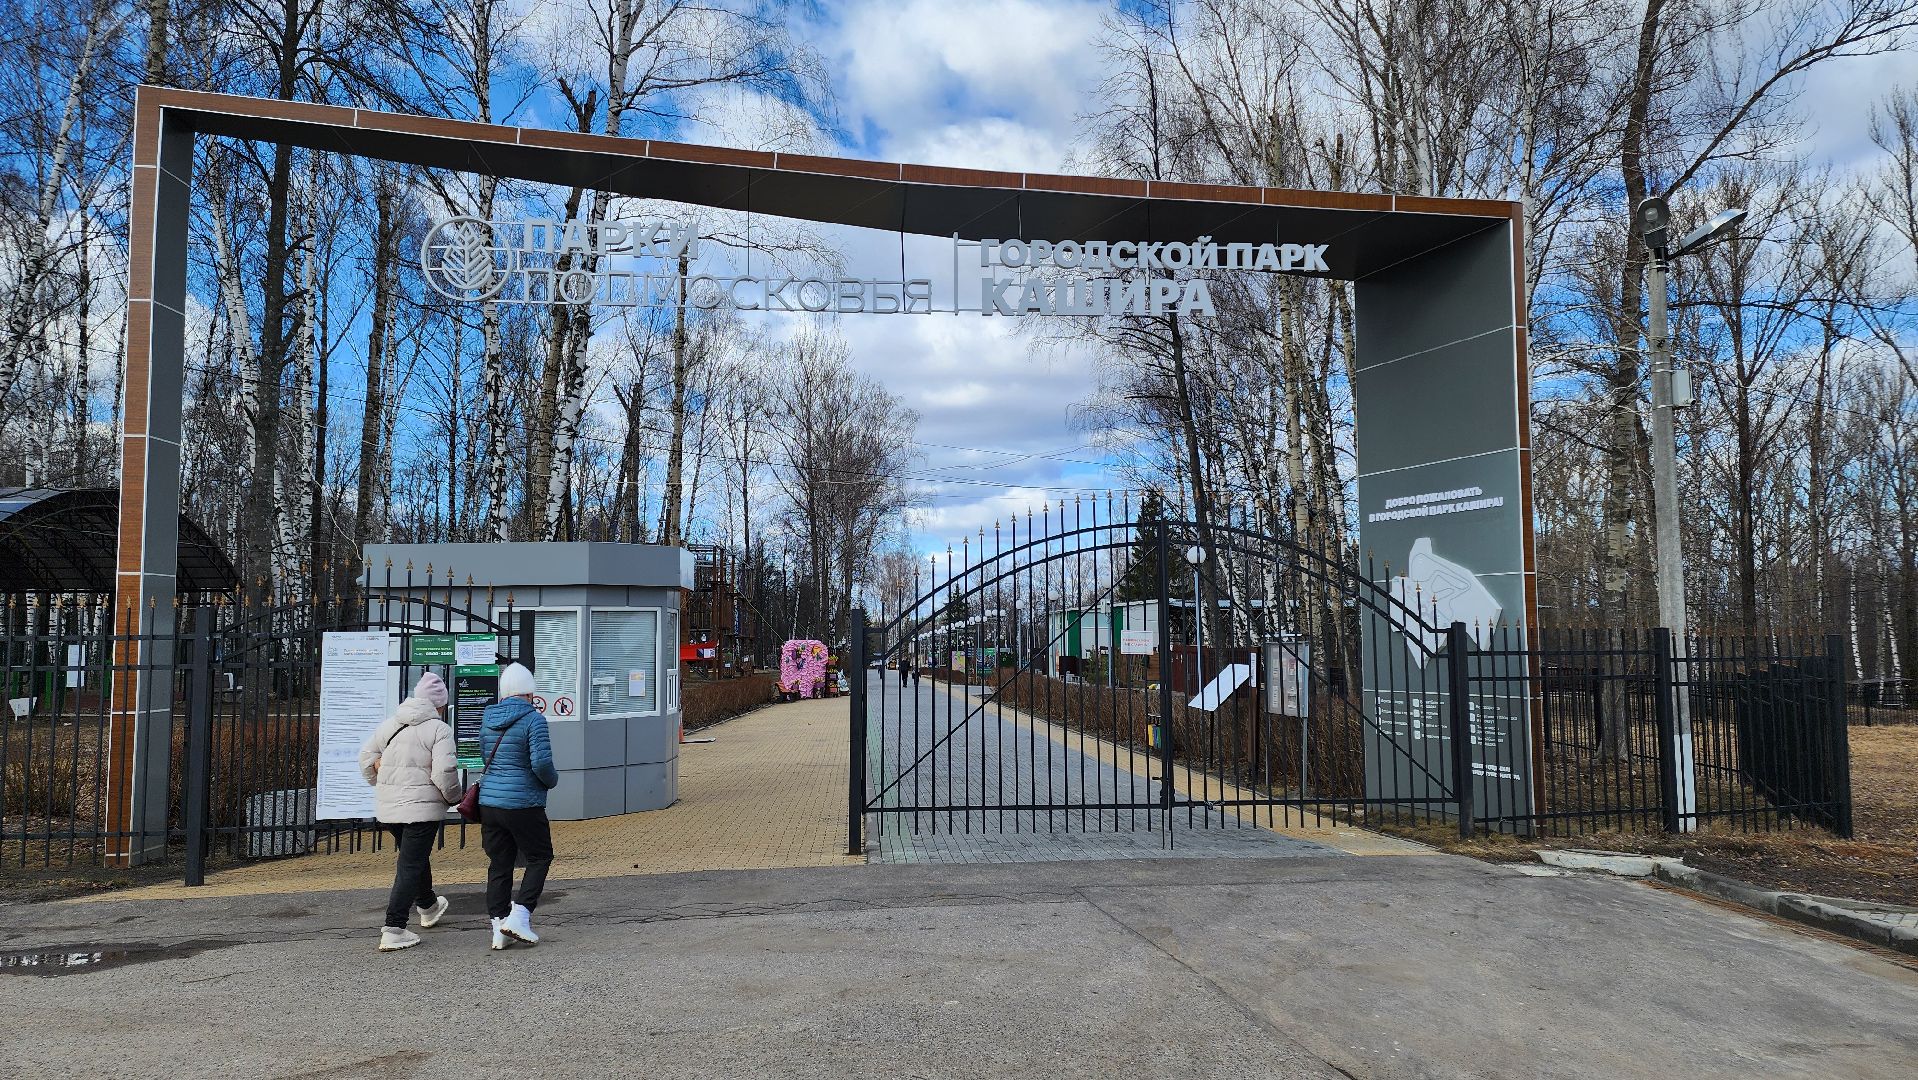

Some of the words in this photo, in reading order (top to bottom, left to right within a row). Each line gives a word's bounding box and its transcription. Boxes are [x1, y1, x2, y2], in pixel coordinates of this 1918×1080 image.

[523, 217, 699, 260] ПАРКИ
[980, 235, 1218, 273] ГОРОДСКОЙ
[1226, 242, 1331, 273] ПАРК
[523, 267, 932, 315] ПОДМОСКОВЬЯ
[980, 277, 1217, 317] КАШИРА
[1368, 513, 1376, 523] В
[1376, 505, 1429, 521] ГОРОДСКОЙ
[1429, 503, 1457, 516] ПАРК
[1385, 495, 1416, 510] ДОБРО
[1416, 487, 1483, 504] ПОЖАЛОВАТЬ
